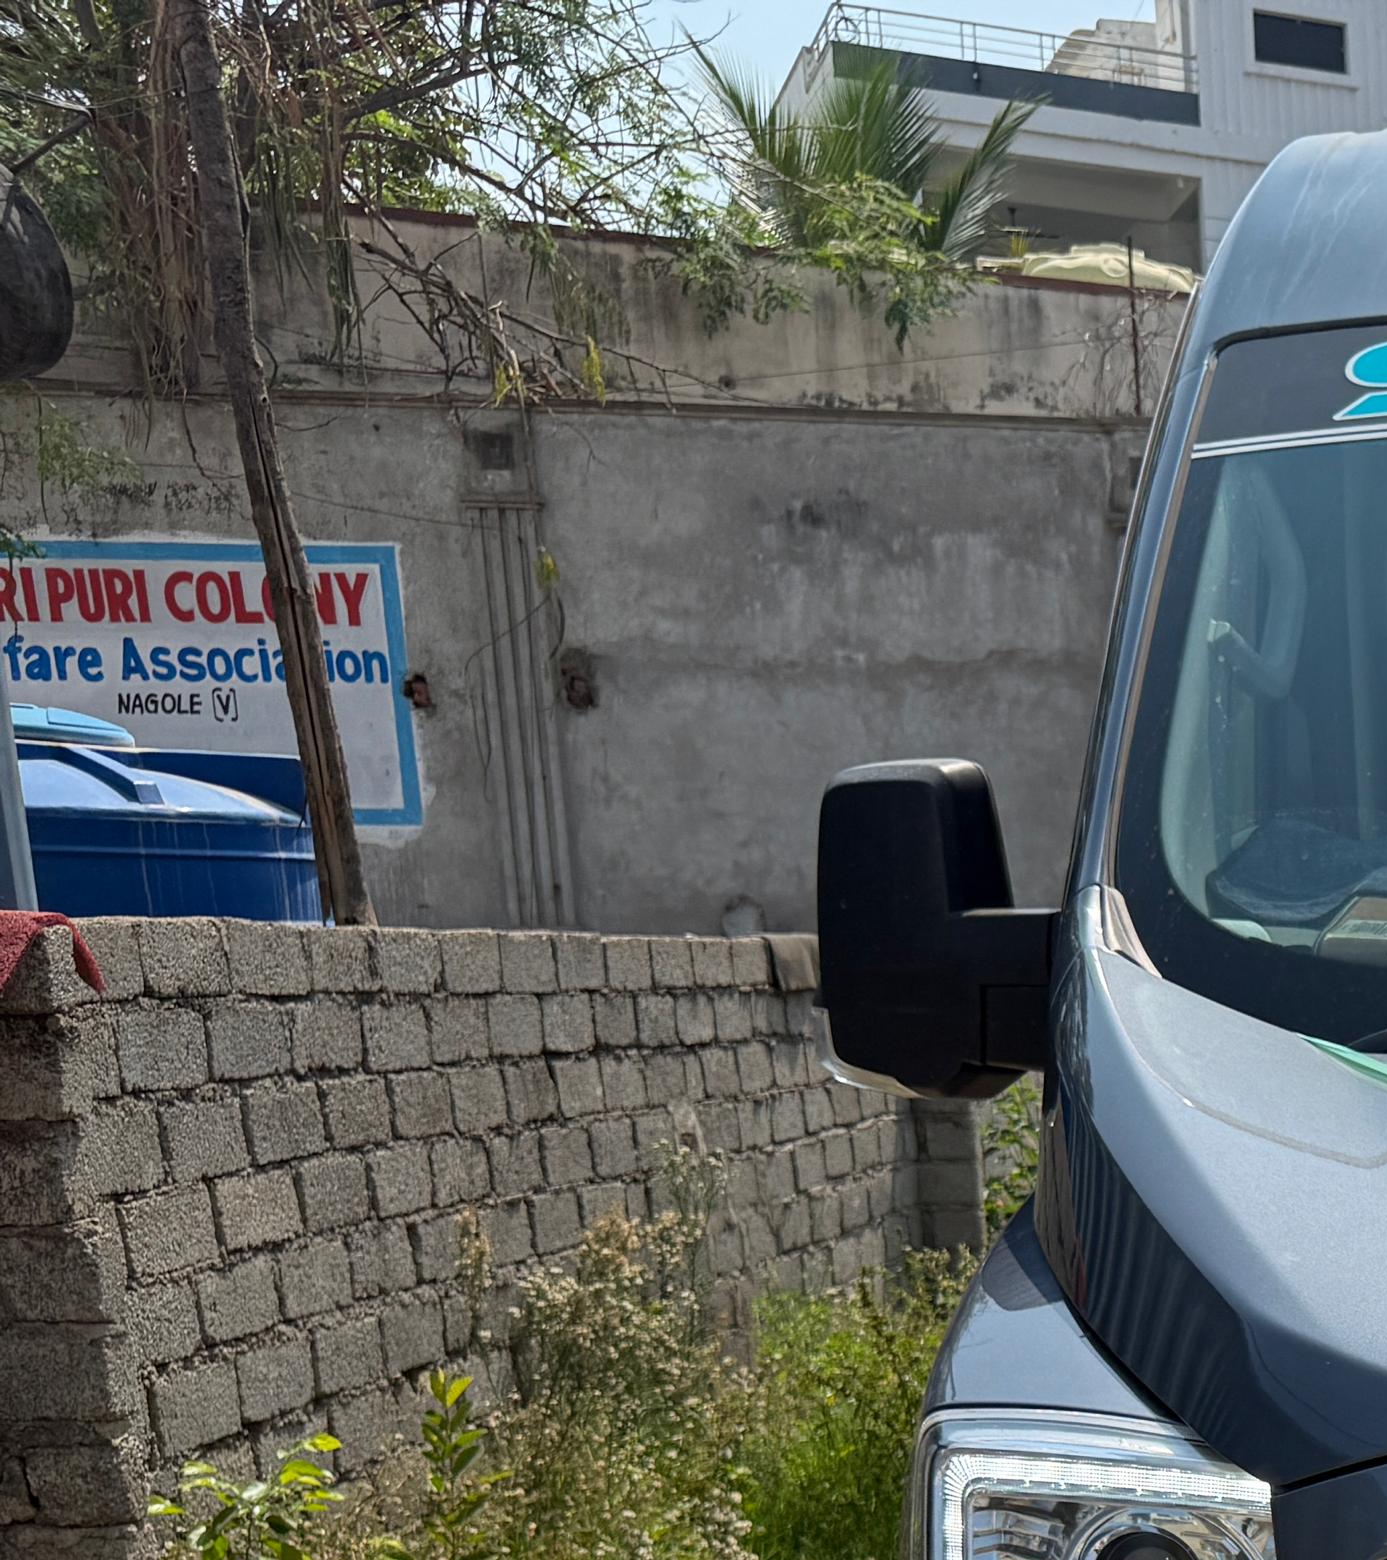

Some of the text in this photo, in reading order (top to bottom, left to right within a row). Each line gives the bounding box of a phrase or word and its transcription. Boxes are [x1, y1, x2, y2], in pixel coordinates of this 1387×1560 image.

[45, 567, 153, 624] PURI
[163, 571, 370, 628] COLNY
[3, 634, 390, 684] fare Associaion
[117, 692, 203, 716] NAGOLE
